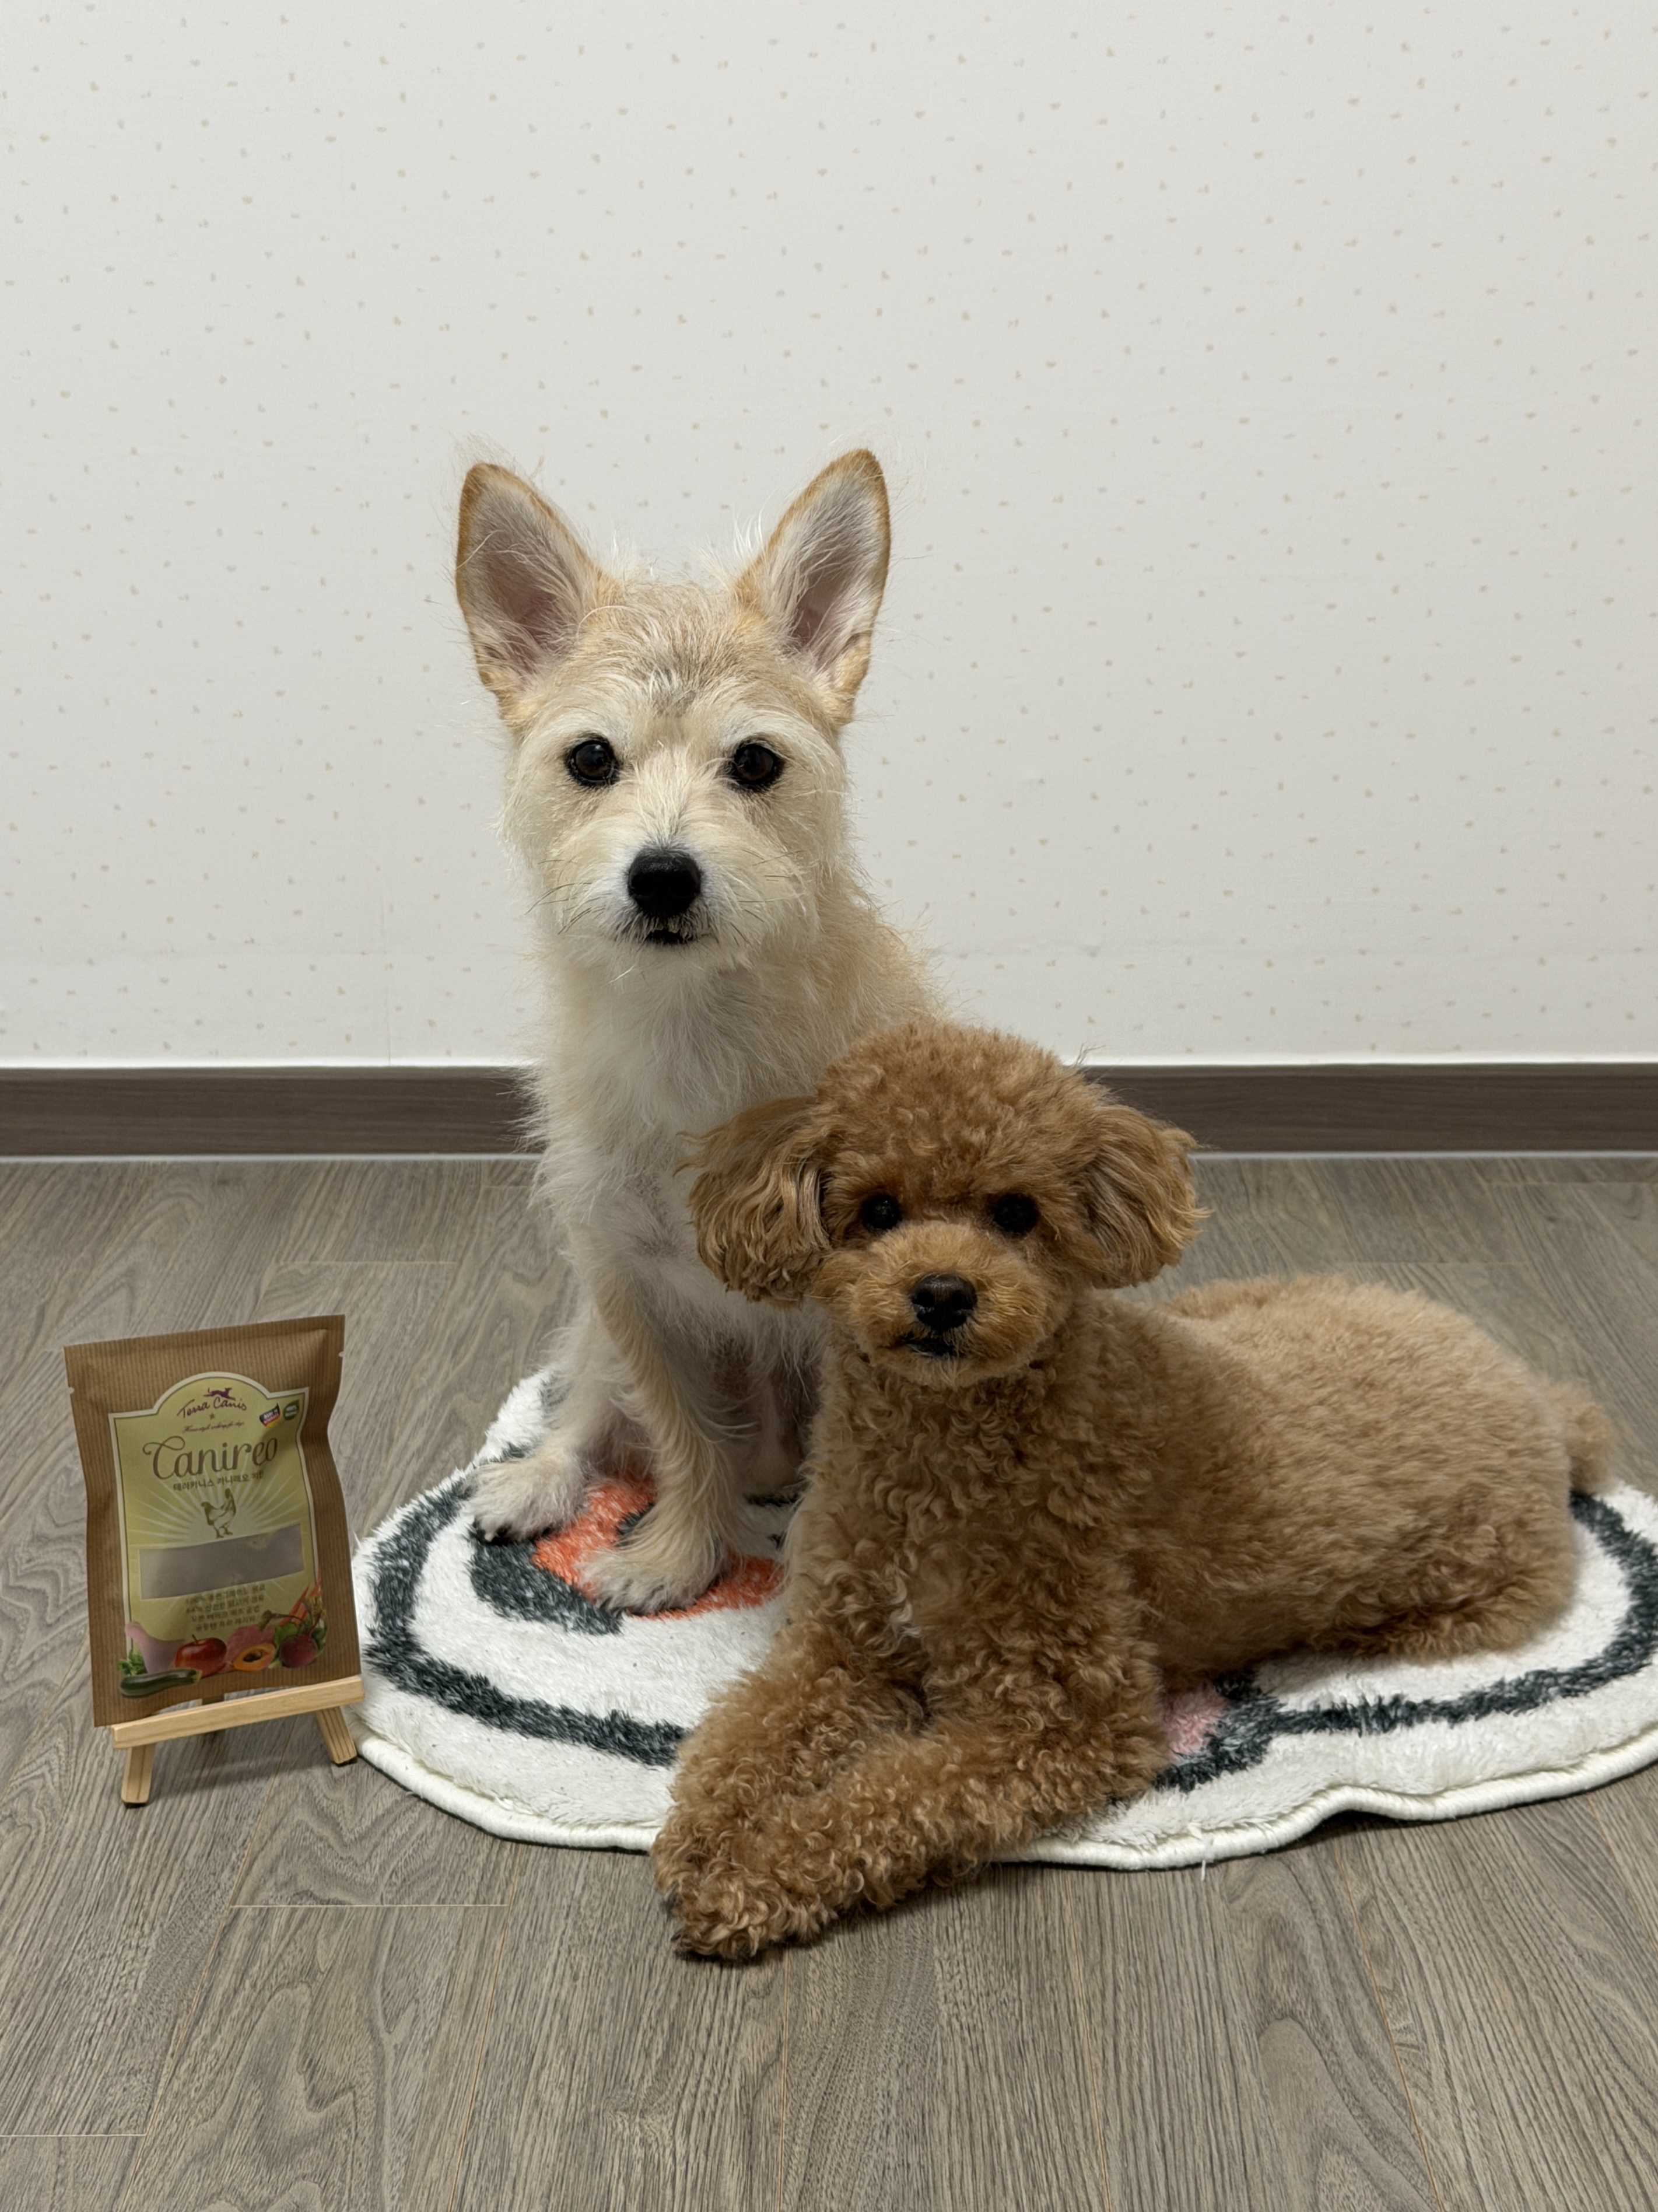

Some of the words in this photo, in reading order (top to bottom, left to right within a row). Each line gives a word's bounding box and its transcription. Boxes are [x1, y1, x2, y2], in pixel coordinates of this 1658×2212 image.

[177, 1398, 210, 1419] Terra
[213, 1396, 247, 1411] Canis
[142, 1436, 278, 1480] Canireo
